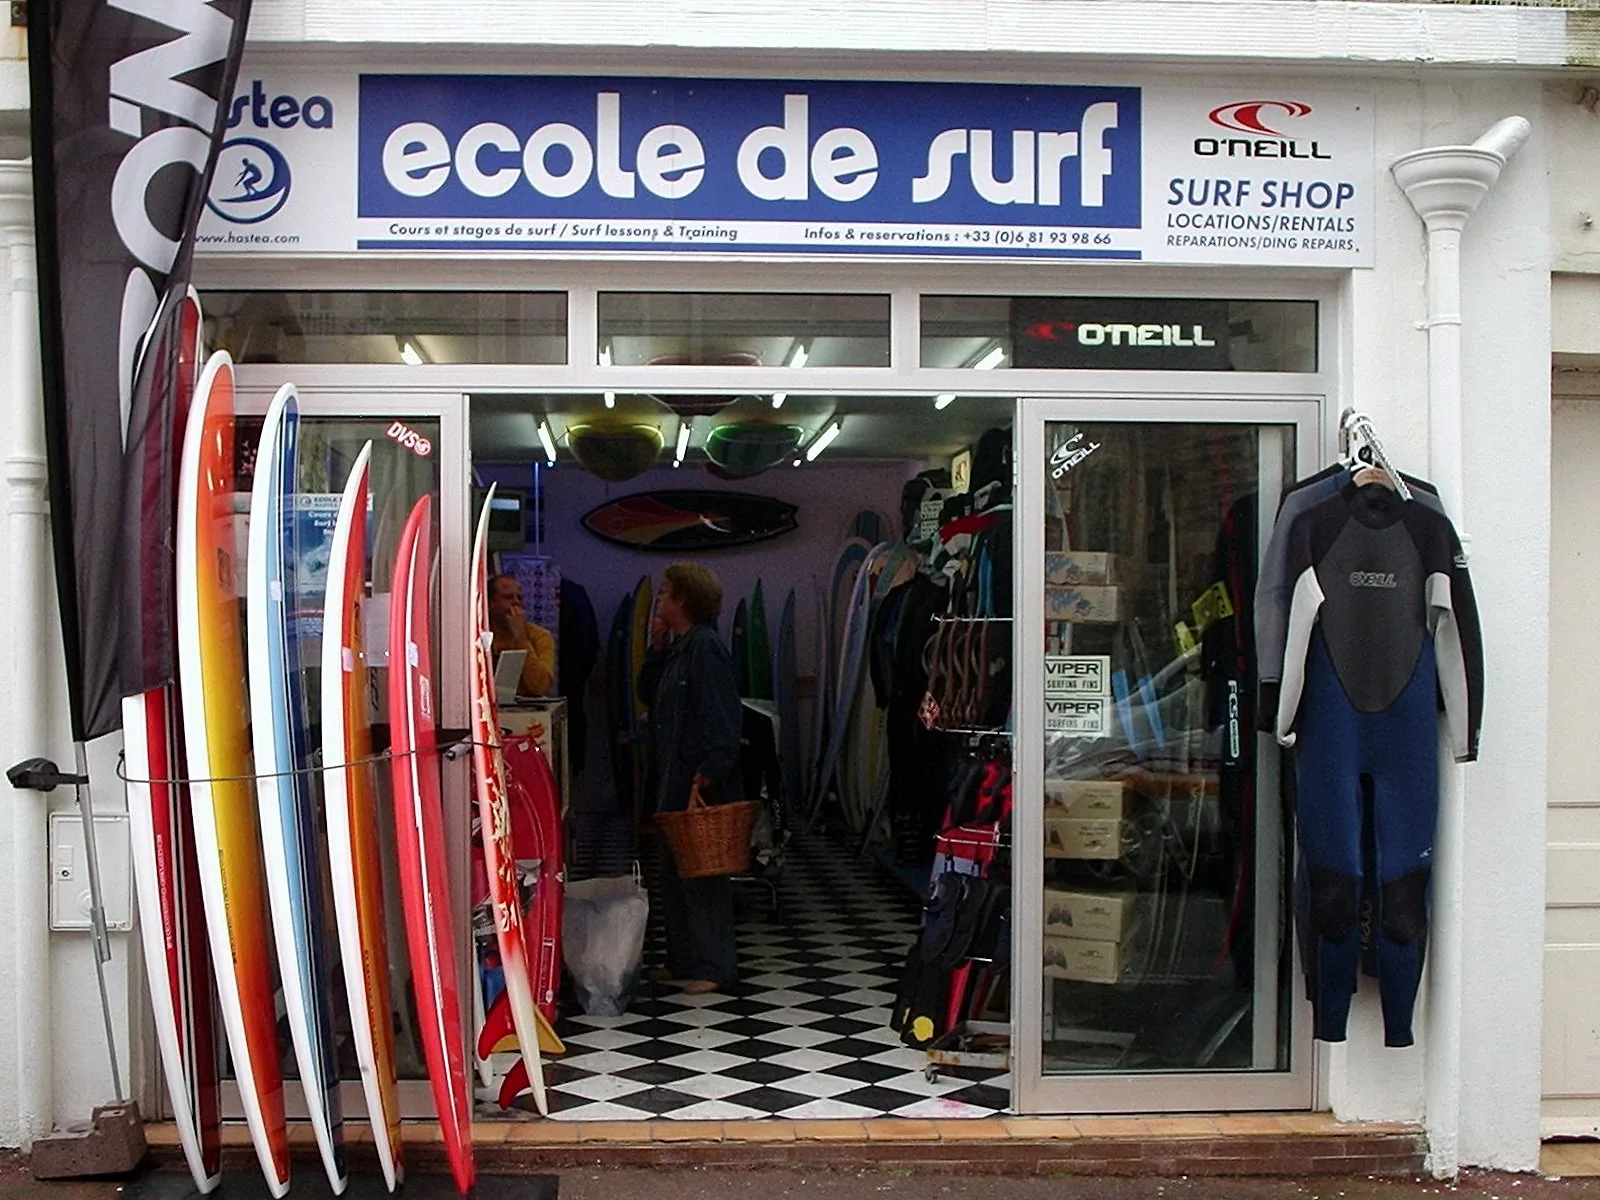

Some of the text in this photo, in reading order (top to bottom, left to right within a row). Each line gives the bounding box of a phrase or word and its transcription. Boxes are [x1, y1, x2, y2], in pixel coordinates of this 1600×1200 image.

[225, 80, 333, 129] stea
[382, 92, 1119, 207] ecole de surf
[1194, 138, 1332, 159] O'NEILL
[1167, 178, 1355, 209] SURF SHOP
[389, 223, 431, 235] Cours
[435, 225, 449, 236] et
[453, 225, 501, 239] stages
[505, 223, 523, 236] de
[527, 223, 558, 236] surf
[572, 224, 603, 237] Surf
[605, 224, 659, 238] lessons
[663, 225, 674, 237] &
[679, 226, 738, 241] Training
[1167, 213, 1355, 233] LOCATIONS/RENTALS
[804, 227, 841, 240] Infos
[845, 228, 855, 240] &
[860, 229, 951, 242] reservations
[963, 230, 991, 242] +33
[994, 230, 1024, 244] (0)6
[1028, 232, 1044, 243] 81
[1050, 232, 1067, 244] 93
[1072, 232, 1089, 244] 98
[1166, 235, 1353, 251] REPARATIONS/DING REPAIRS
[1078, 323, 1216, 347] O'NEILL
[387, 421, 420, 448] DVS
[1045, 663, 1099, 675] VIPER
[1047, 680, 1099, 689] SURFING FINS
[1046, 702, 1100, 714] VIPER
